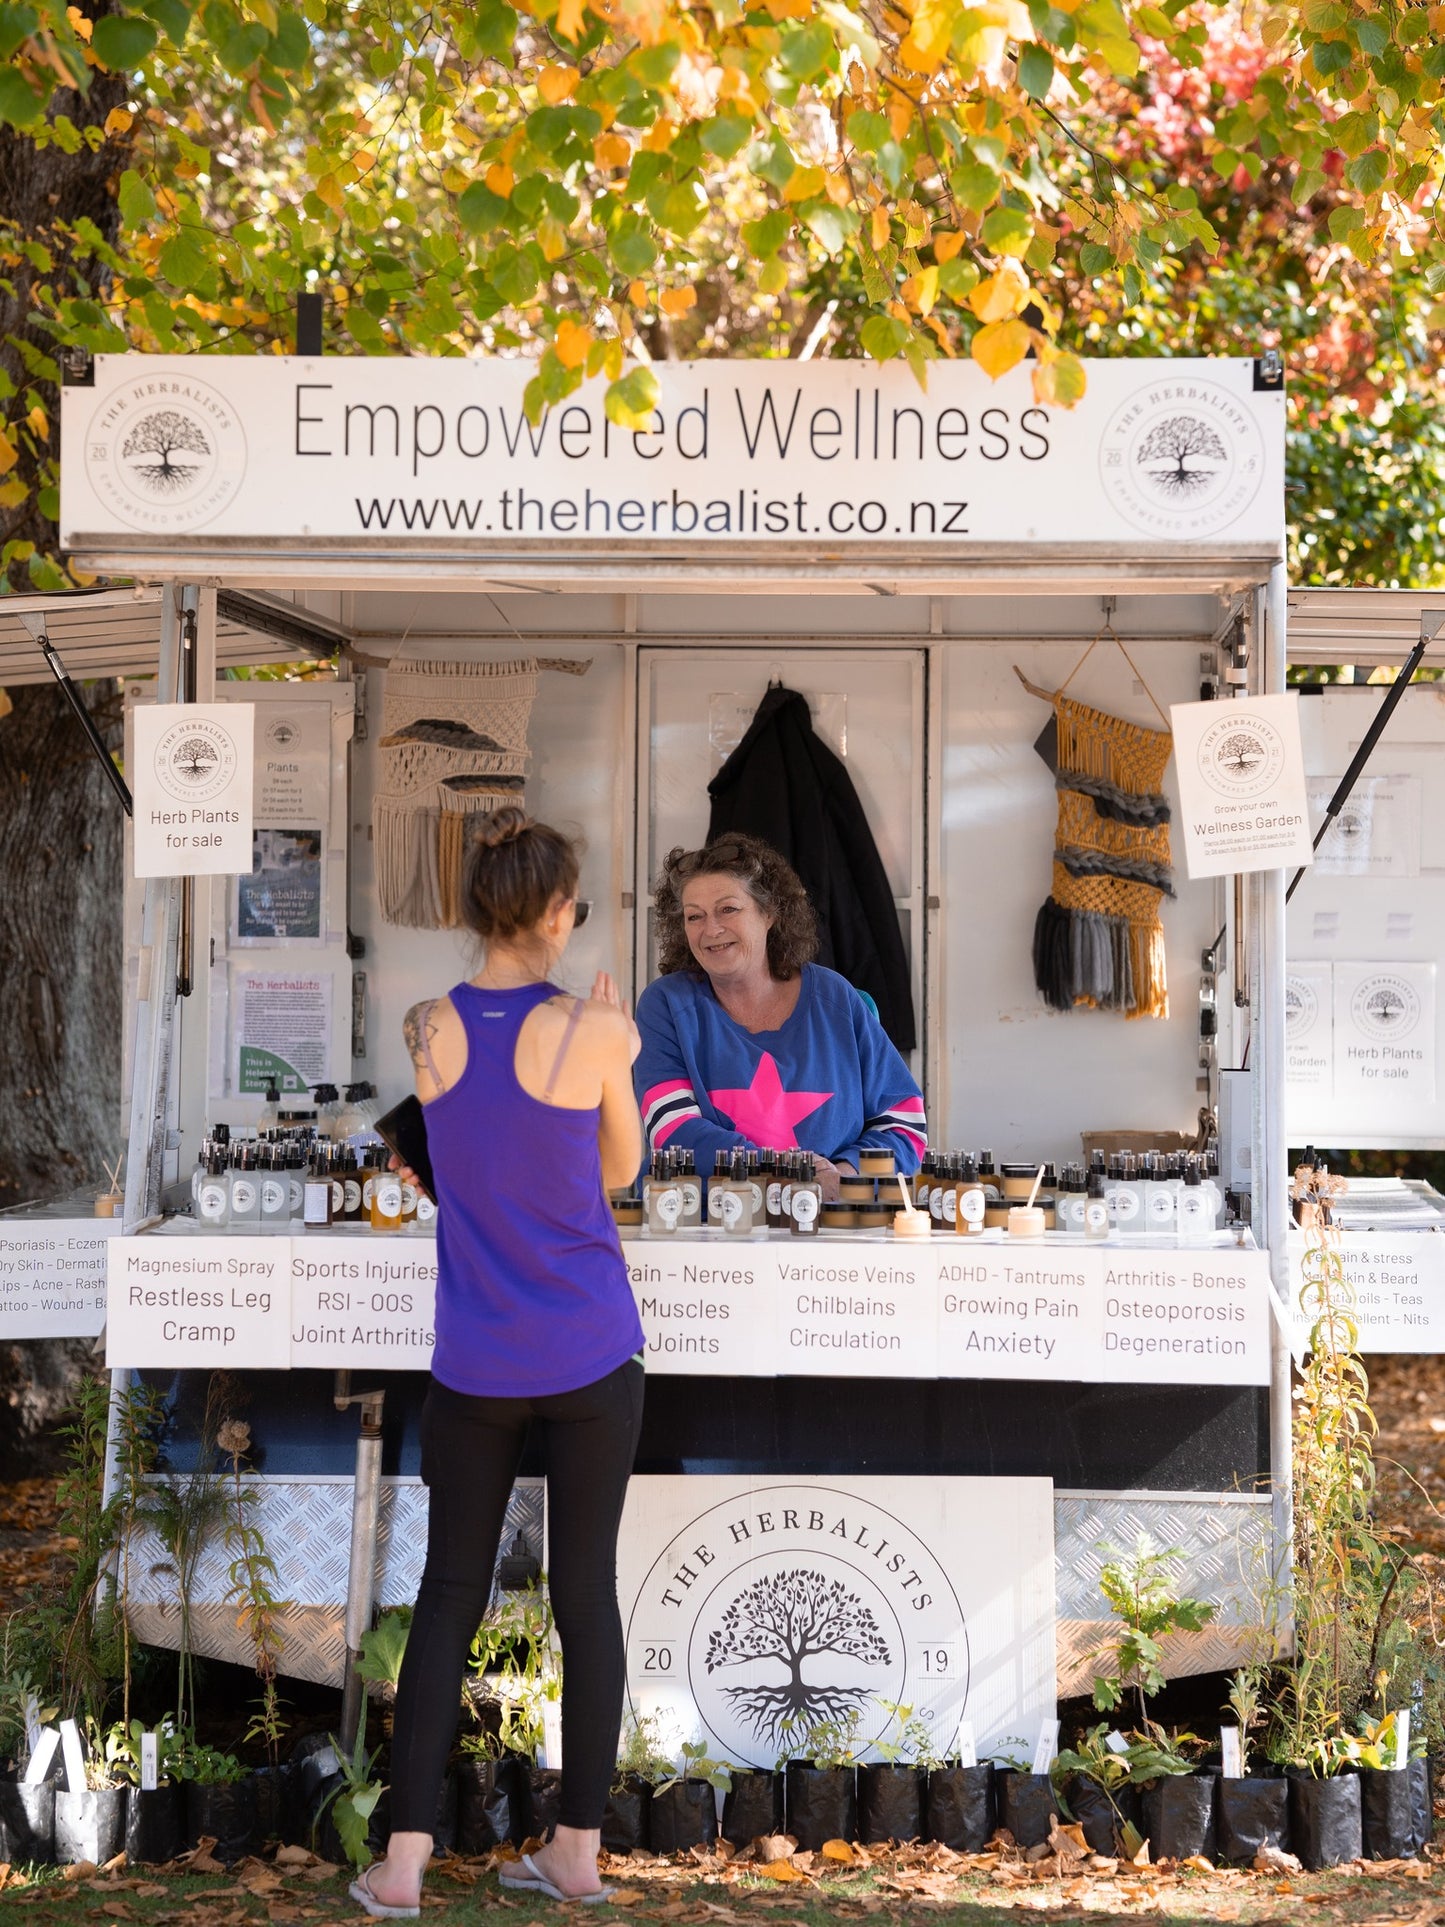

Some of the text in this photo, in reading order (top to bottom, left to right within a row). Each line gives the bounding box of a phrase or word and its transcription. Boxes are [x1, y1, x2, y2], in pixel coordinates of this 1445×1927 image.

[100, 382, 232, 431] THE HERBALISTS
[1115, 387, 1250, 435] THE HERBALISTS
[295, 384, 1052, 476] Empowered Wellness
[355, 487, 970, 533] www.theherbalist.co.nz
[162, 723, 229, 750] THE HERBALISTS
[1205, 719, 1274, 748] THE HERBALISTS
[267, 762, 299, 773] Plants
[150, 809, 240, 825] Herb Plants
[1214, 800, 1278, 815] Grow your own
[1193, 814, 1303, 836] Wellness Garden
[166, 832, 223, 848] for sale
[247, 980, 320, 991] The Herbalists
[246, 1058, 272, 1066] This is
[1289, 1055, 1327, 1067] Garden
[1347, 1046, 1423, 1060] Herb Plants
[246, 1068, 281, 1077] Helena's
[1361, 1066, 1409, 1079] for sale
[0, 1239, 56, 1251] Psoriasis
[18, 1259, 44, 1271] Skin
[56, 1258, 107, 1270] Dermati
[127, 1257, 275, 1277] Magnesium Spray
[1361, 1252, 1371, 1263] &
[1374, 1253, 1413, 1265] stress
[291, 1258, 439, 1284] Sports Injuries
[684, 1264, 754, 1285] Nerves
[778, 1263, 916, 1285] Varicose Veins
[939, 1265, 987, 1282] ADHD
[1004, 1267, 1086, 1287] Tantrums
[1105, 1270, 1176, 1287] Arthritis
[1192, 1272, 1247, 1289] Bones
[1368, 1272, 1377, 1284] &
[1381, 1272, 1418, 1285] Beard
[32, 1279, 63, 1290] Acne
[75, 1277, 107, 1289] Rash
[41, 1299, 84, 1310] Wound
[129, 1286, 272, 1312] Restless Leg
[318, 1292, 350, 1311] RSI
[371, 1293, 413, 1313] OOS
[641, 1298, 730, 1319] Muscles
[796, 1295, 896, 1316] Chilblains
[944, 1294, 1079, 1320] Growing Pain
[1359, 1292, 1380, 1304] oils
[1393, 1293, 1423, 1305] Teas
[1106, 1298, 1246, 1323] Osteoporosis
[1403, 1313, 1430, 1325] Nits
[162, 1320, 236, 1346] Cramp
[292, 1325, 436, 1347] Joint Arthritis
[648, 1332, 720, 1353] Joints
[789, 1328, 901, 1350] Circulation
[965, 1330, 1056, 1360] Anxiety
[1104, 1332, 1246, 1356] Degeneration
[661, 1509, 933, 1613] THE HERBALISTS
[644, 1647, 672, 1671] 20
[922, 1648, 949, 1673] 19
